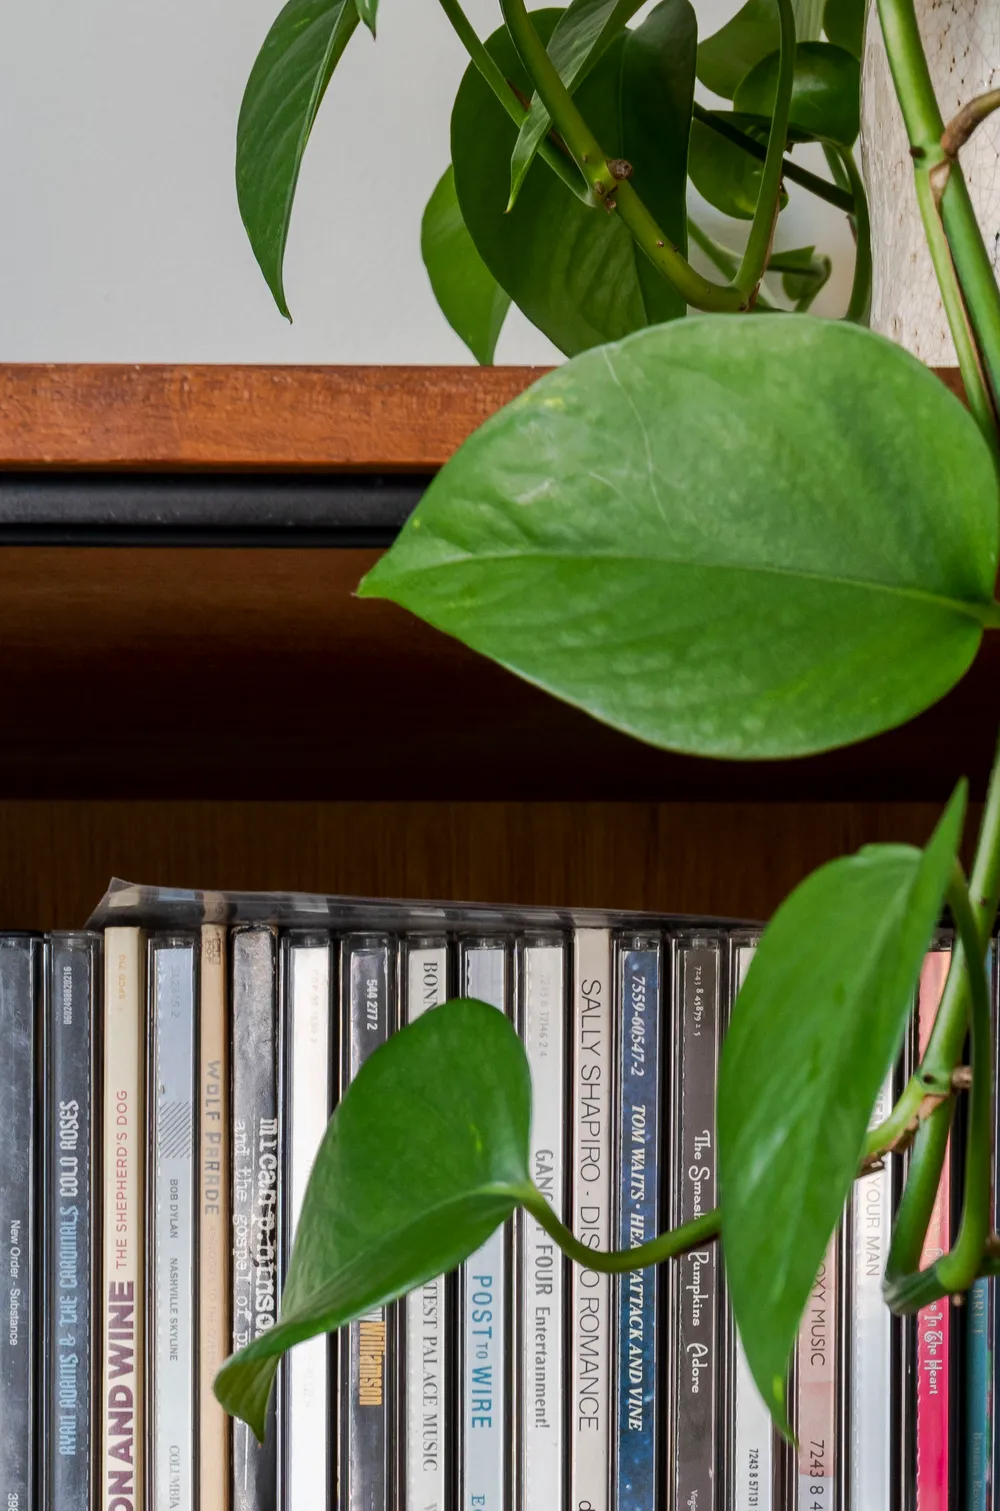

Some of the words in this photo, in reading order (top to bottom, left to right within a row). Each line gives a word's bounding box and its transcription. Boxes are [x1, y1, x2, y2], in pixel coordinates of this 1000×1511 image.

[367, 979, 378, 999] 544
[367, 1000, 378, 1020] 277
[581, 979, 602, 1057] SALLY
[630, 975, 646, 1076] 7559-60547-2
[116, 1090, 128, 1126] DOG
[205, 1060, 221, 1122] WOLF
[58, 1099, 79, 1150] ROSES
[234, 1120, 248, 1156] and
[581, 1064, 602, 1182] SHAPIRO
[630, 1104, 646, 1143] TOM
[693, 1129, 710, 1160] The
[169, 1179, 178, 1202] BOB
[236, 1167, 251, 1202] the
[630, 1148, 646, 1201] WAITS
[169, 1204, 178, 1239] DYLAN
[865, 1178, 881, 1230] YOUR
[10, 1220, 21, 1244] New
[116, 1239, 127, 1270] THE
[232, 1214, 250, 1281] gospel
[866, 1235, 880, 1276] MAN
[9, 1248, 21, 1280] Order
[169, 1257, 178, 1315] NASHVILLE
[535, 1244, 553, 1296] FOUR
[686, 1252, 709, 1327] Pumpkins
[9, 1289, 21, 1347] Substance
[107, 1280, 134, 1379] WINE
[472, 1275, 492, 1340] POST
[169, 1317, 178, 1361] SKYLINE
[475, 1343, 489, 1360] TO
[810, 1309, 826, 1366] MUSIC
[422, 1336, 438, 1407] PALACE
[534, 1306, 552, 1429] Entertainment!
[579, 1297, 600, 1432] ROMANCE
[628, 1345, 643, 1384] AND
[686, 1343, 708, 1393] Adore
[472, 1366, 492, 1429] WIRE
[628, 1388, 643, 1432] VINE
[107, 1385, 134, 1464] AND
[422, 1413, 438, 1472] MUSIC
[168, 1445, 181, 1509] COLUMBIA
[748, 1448, 759, 1471] 7243
[809, 1439, 825, 1478] 7243
[748, 1480, 759, 1507] 57131
